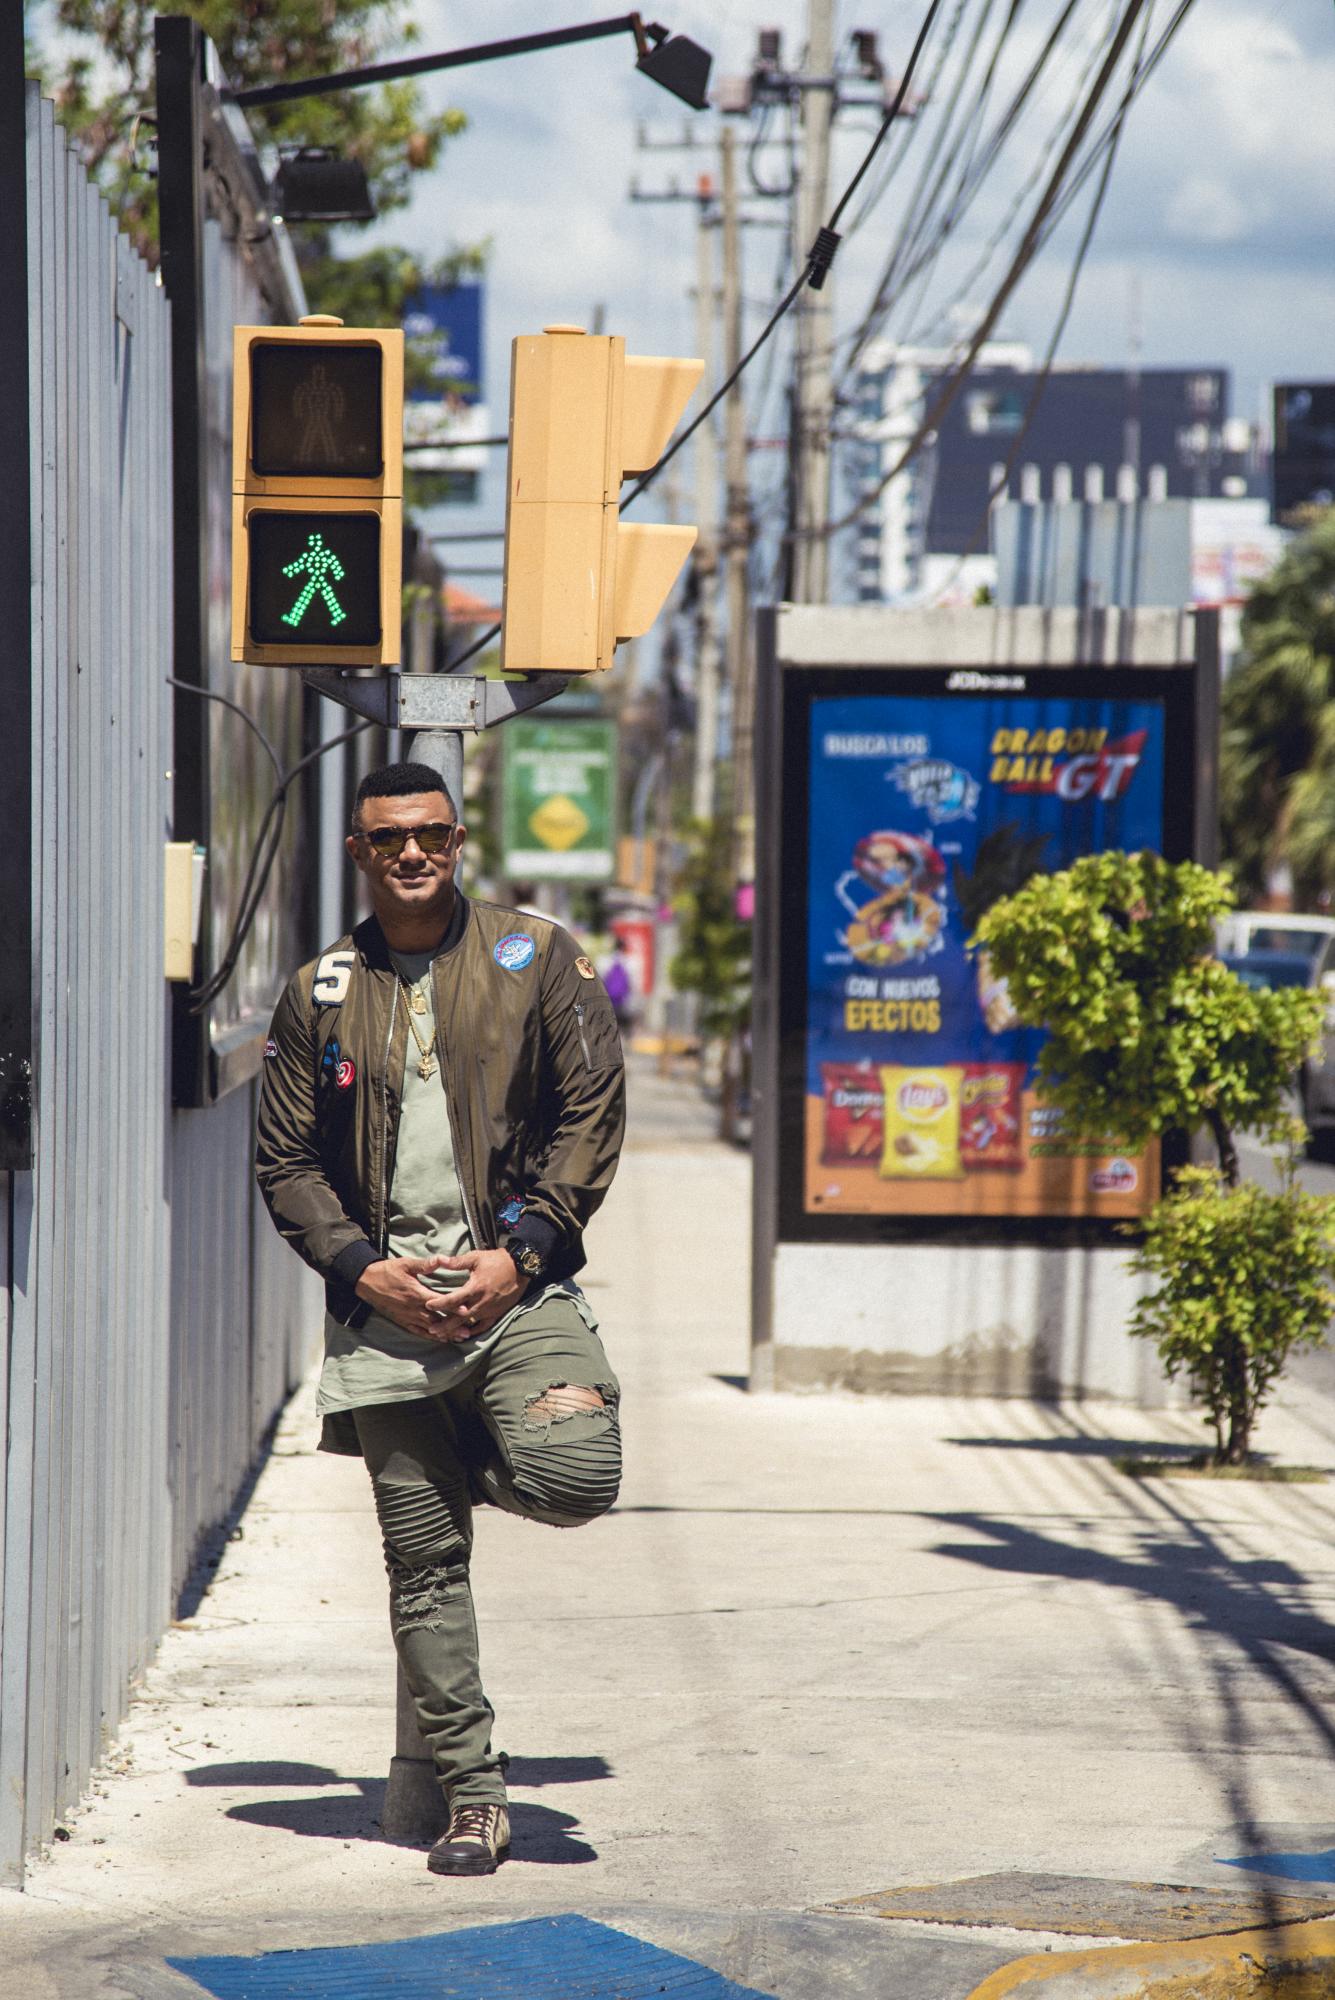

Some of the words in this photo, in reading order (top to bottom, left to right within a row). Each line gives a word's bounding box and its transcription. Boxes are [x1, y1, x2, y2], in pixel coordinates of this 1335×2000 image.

[991, 727, 1108, 753] DRAGON
[990, 757, 1053, 782] BALL
[1057, 754, 1140, 800] GT
[312, 950, 356, 1008] 5
[845, 975, 878, 998] CON
[882, 974, 941, 999] NUEVOS
[844, 1000, 941, 1033] EFECTOS
